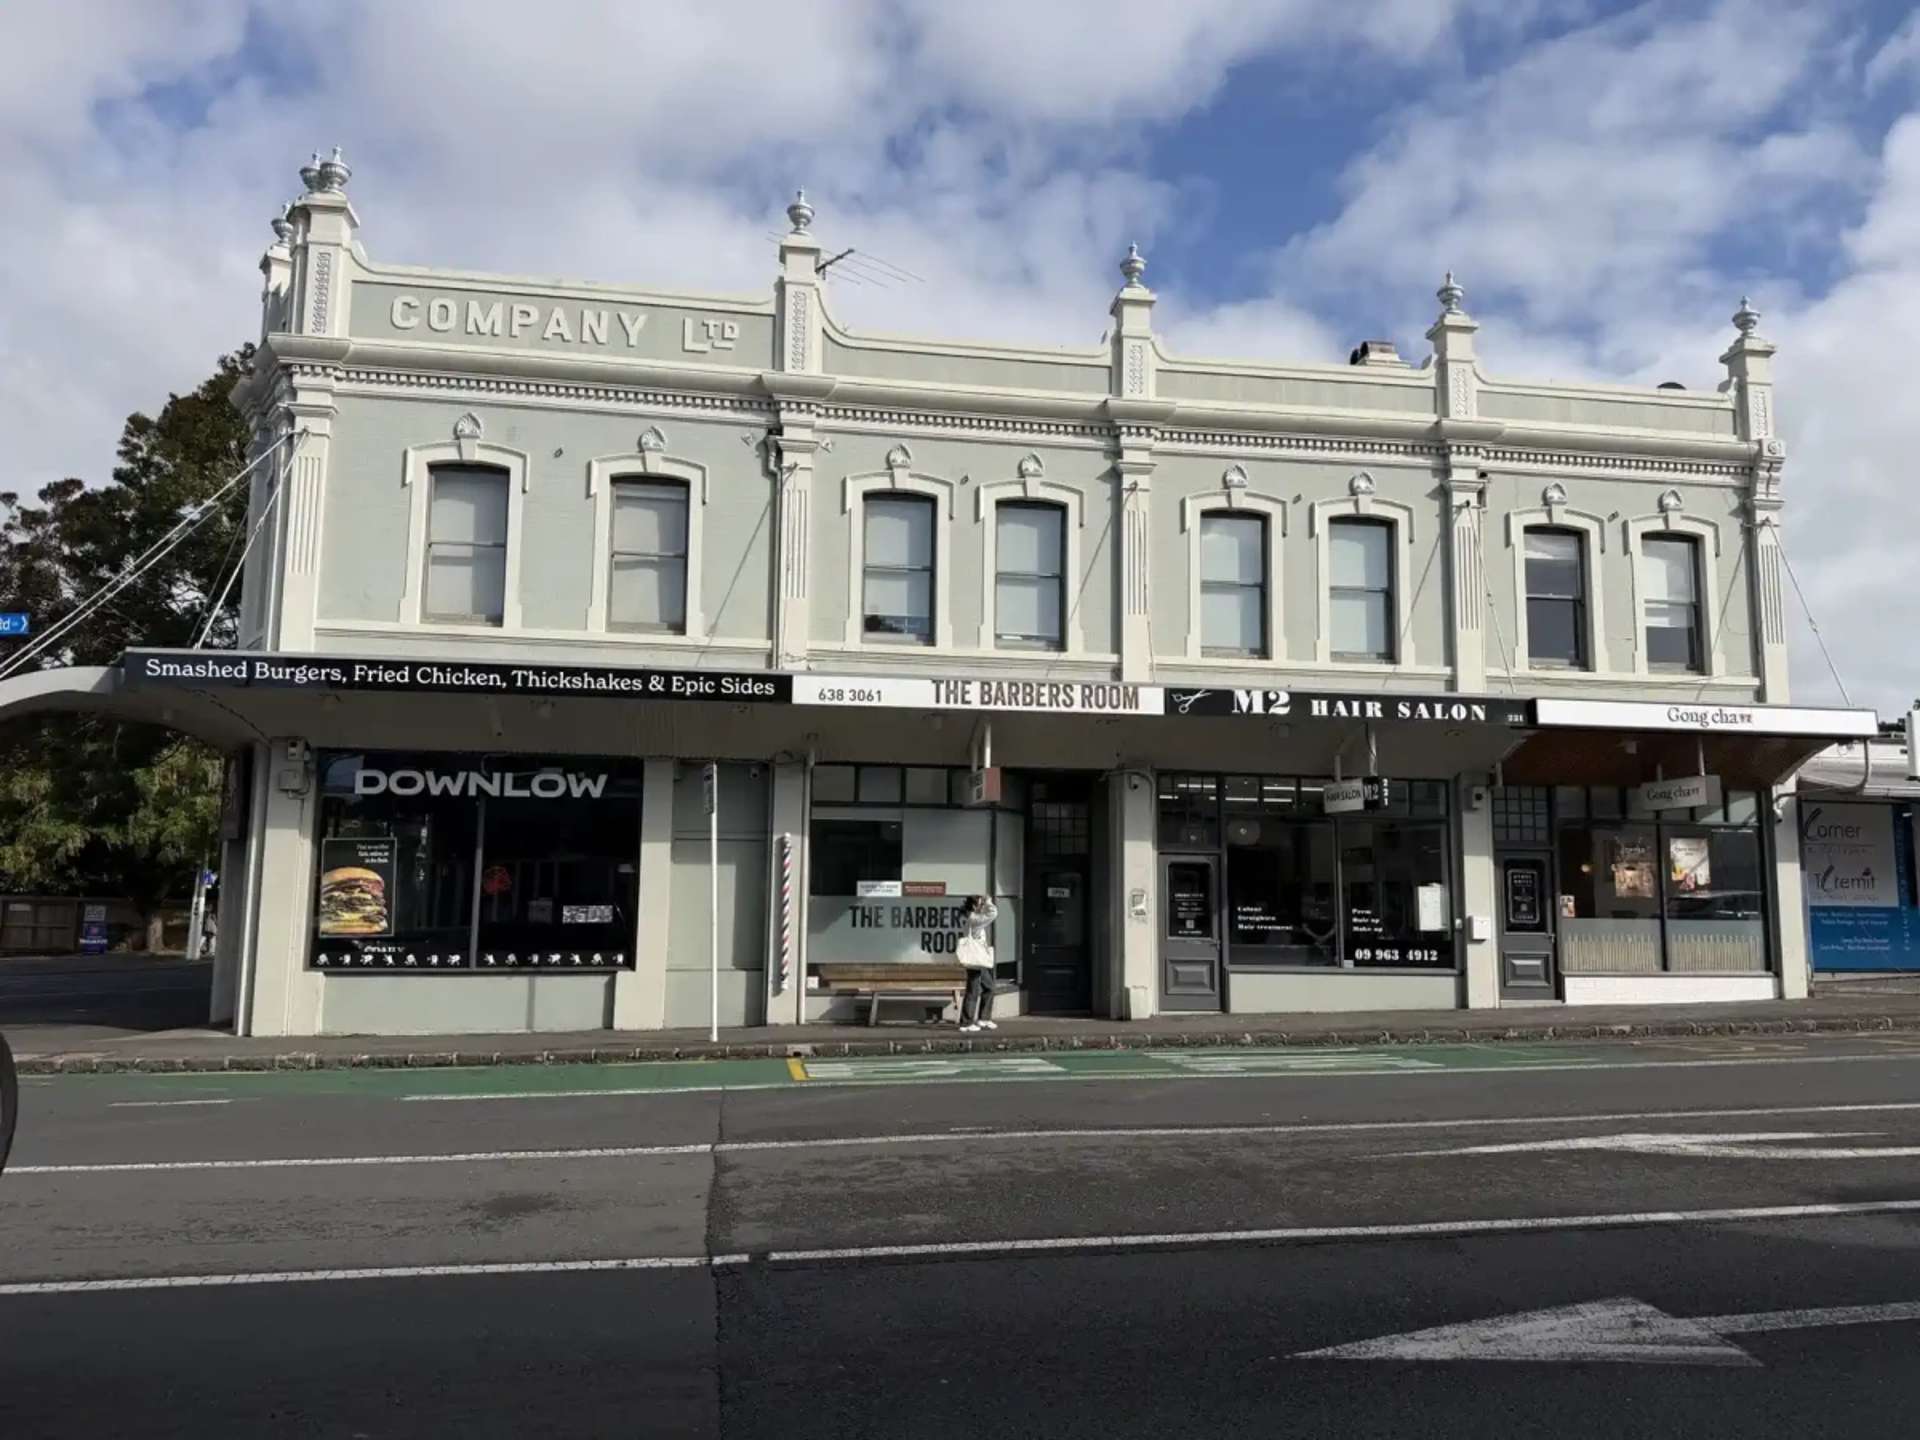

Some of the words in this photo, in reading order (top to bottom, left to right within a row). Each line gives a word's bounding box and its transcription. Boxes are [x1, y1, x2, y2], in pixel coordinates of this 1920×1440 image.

[390, 295, 648, 347] COMPANY
[146, 658, 247, 678] Smashed
[254, 662, 347, 684] Burgers,
[354, 664, 409, 683] Fried
[416, 666, 507, 688] Chicken,
[511, 669, 643, 691] Thickshakes
[648, 675, 665, 691] &
[671, 676, 716, 696] Epic
[720, 677, 775, 695] Sides
[818, 688, 844, 702] 638
[849, 689, 882, 702] 3061
[931, 679, 972, 705] THE
[980, 680, 1075, 708] BARBERS
[1081, 684, 1140, 710] ROOM
[1231, 689, 1291, 715] M2
[1311, 699, 1384, 719] HAIR
[1397, 701, 1487, 721] SALON
[1667, 706, 1709, 728] Gong
[1711, 708, 1738, 724] cha
[354, 769, 608, 798] DOWNLOW
[1647, 785, 1673, 801] Gong
[849, 905, 884, 928] THE
[1354, 948, 1372, 960] 09
[1375, 949, 1399, 961] 963
[1406, 949, 1438, 961] 4912
